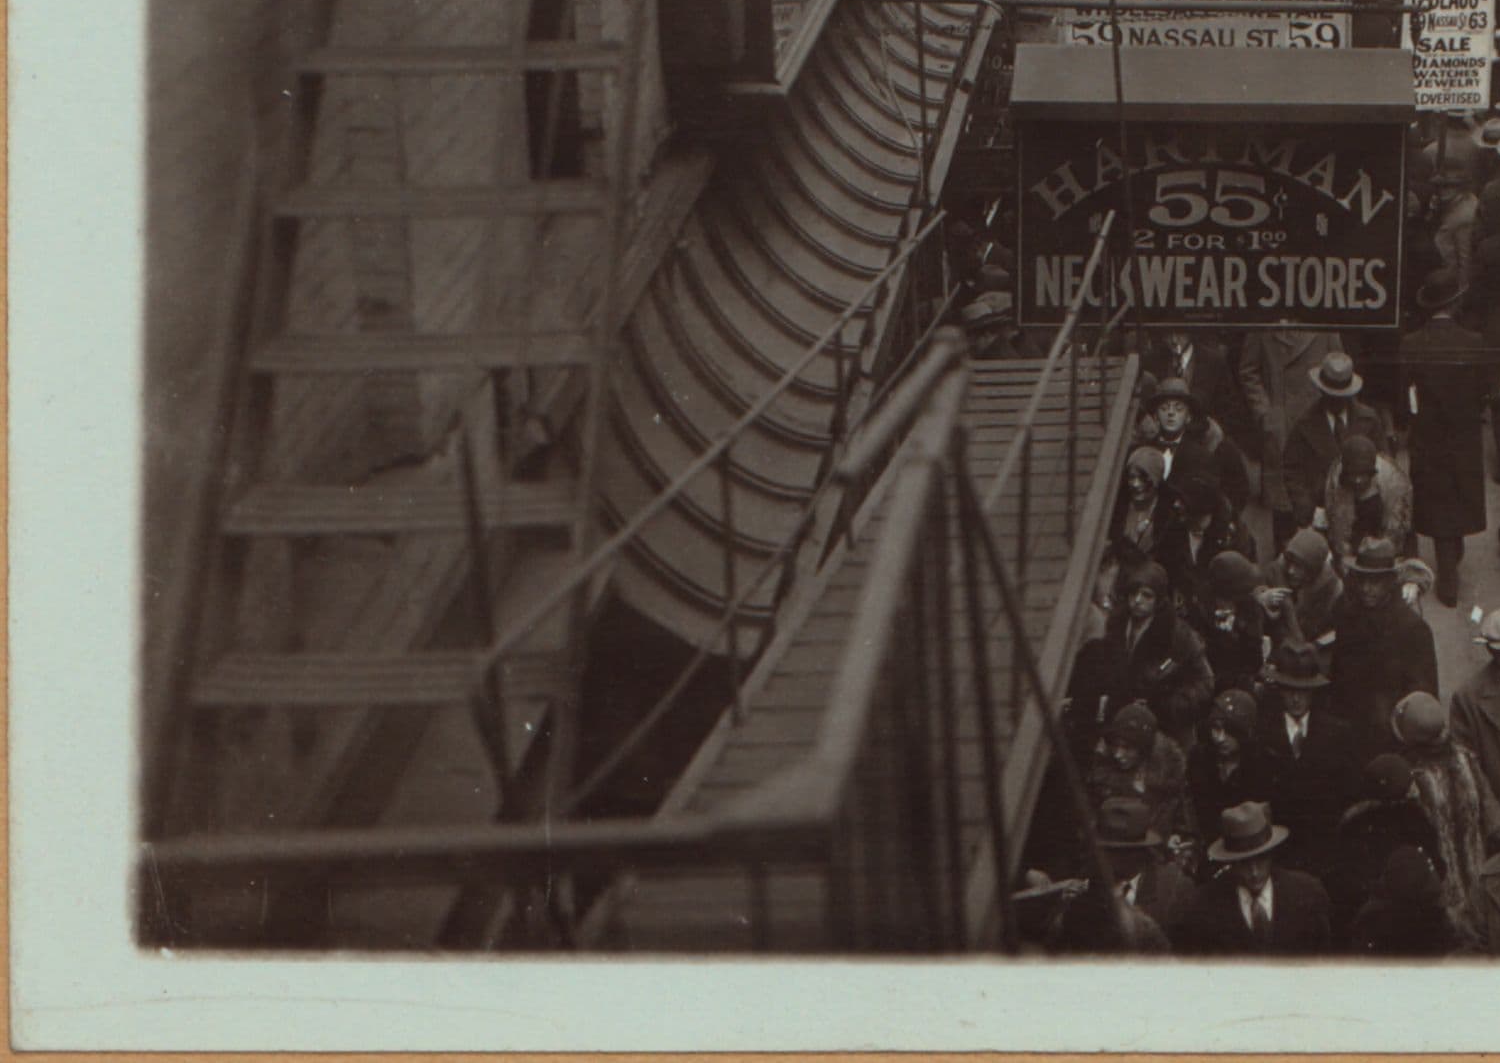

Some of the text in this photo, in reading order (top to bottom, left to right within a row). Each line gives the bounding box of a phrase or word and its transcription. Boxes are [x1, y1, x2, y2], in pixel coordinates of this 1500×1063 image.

[1469, 12, 1487, 29] 63
[1129, 28, 1235, 48] NASSAU
[1417, 37, 1471, 53] SALE
[1413, 54, 1486, 69] DIAMONDS
[1414, 69, 1479, 79] WATCHES
[1415, 78, 1480, 88] JEWELRY
[1133, 230, 1155, 250] 2
[1166, 233, 1227, 251] FOR
[1034, 255, 1387, 310] NECKWEAR STORES
